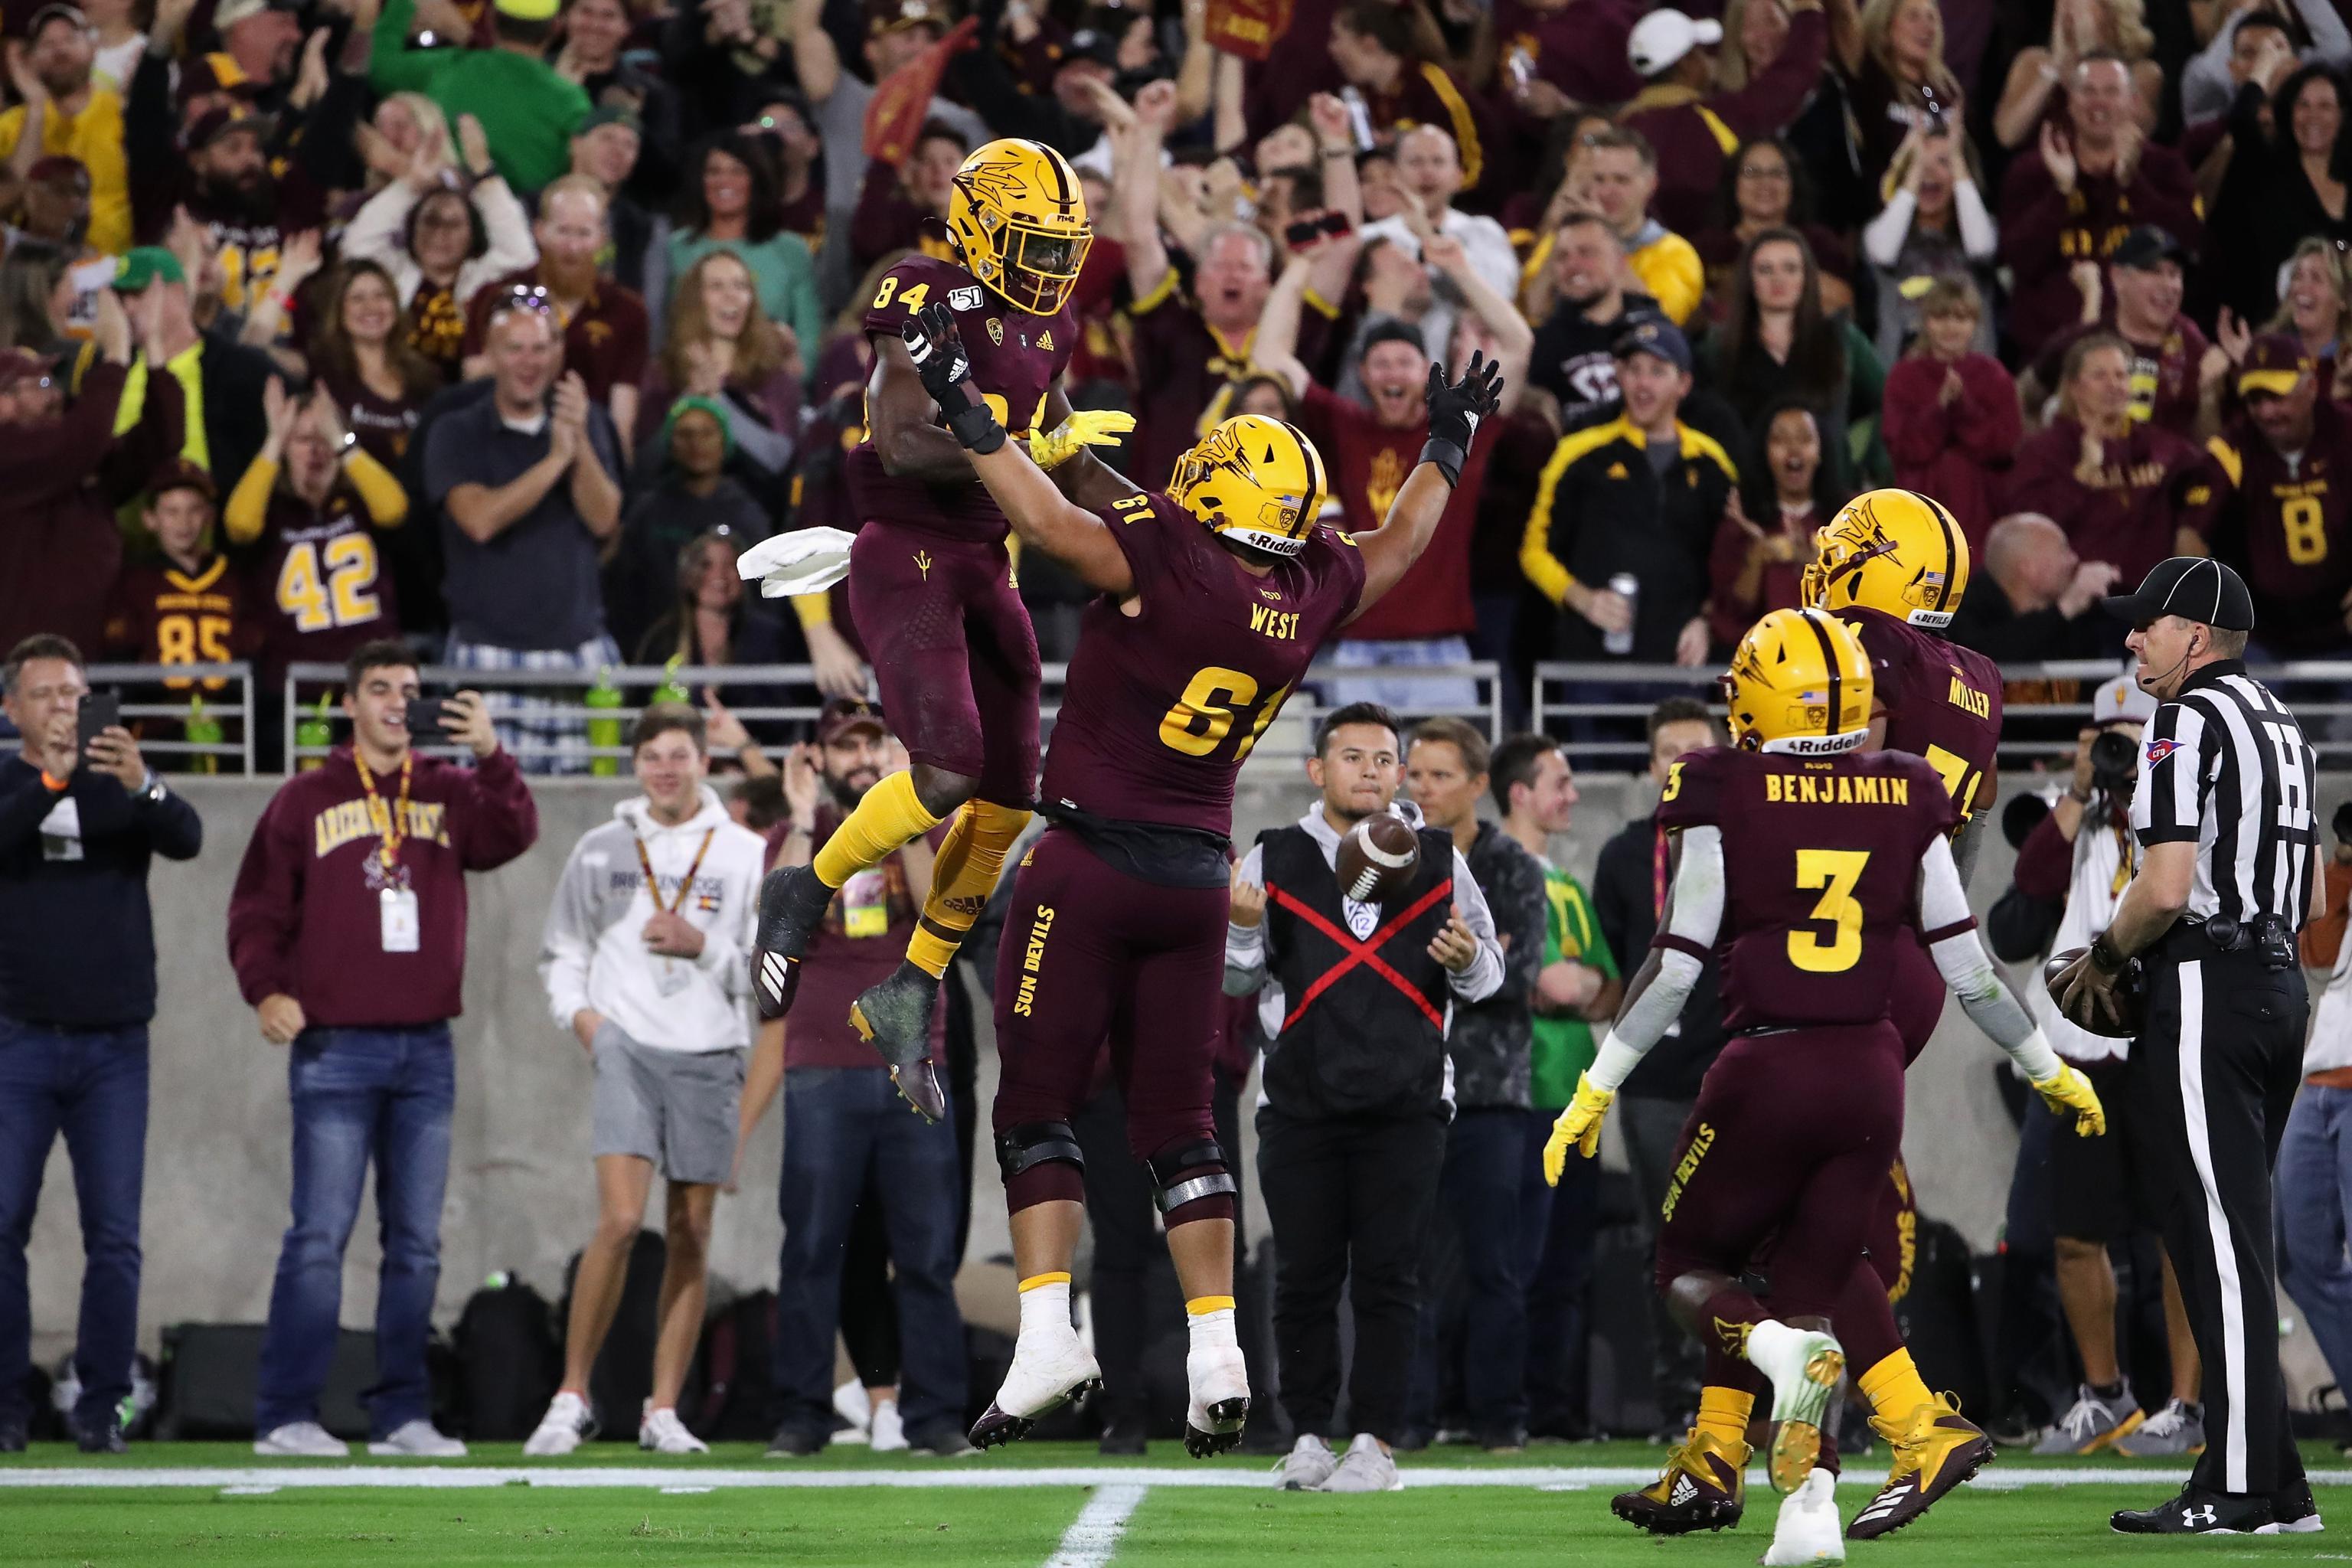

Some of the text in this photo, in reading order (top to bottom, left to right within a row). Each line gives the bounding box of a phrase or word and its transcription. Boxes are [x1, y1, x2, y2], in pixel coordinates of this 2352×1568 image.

[873, 276, 930, 315] 84
[948, 361, 969, 383] adidas
[1112, 494, 1156, 524] 61
[2282, 494, 2329, 565] 8
[275, 531, 382, 633] 42
[1250, 602, 1300, 641] WEST
[1921, 614, 1949, 625] DEVILS
[157, 614, 233, 690] 85
[1158, 666, 1295, 763] 61
[1948, 675, 1991, 720] MILLER
[1799, 733, 1862, 753] Riddell
[1662, 762, 1687, 802] 3
[1766, 774, 1909, 806] BENJAMIN
[2261, 720, 2311, 831] H
[1356, 918, 1370, 931] 12
[1787, 849, 1871, 972] 3
[1014, 904, 1055, 1018] SUN DEVILS
[1662, 1122, 1715, 1223] SUN DEVILS
[1671, 1488, 1698, 1507] adidas
